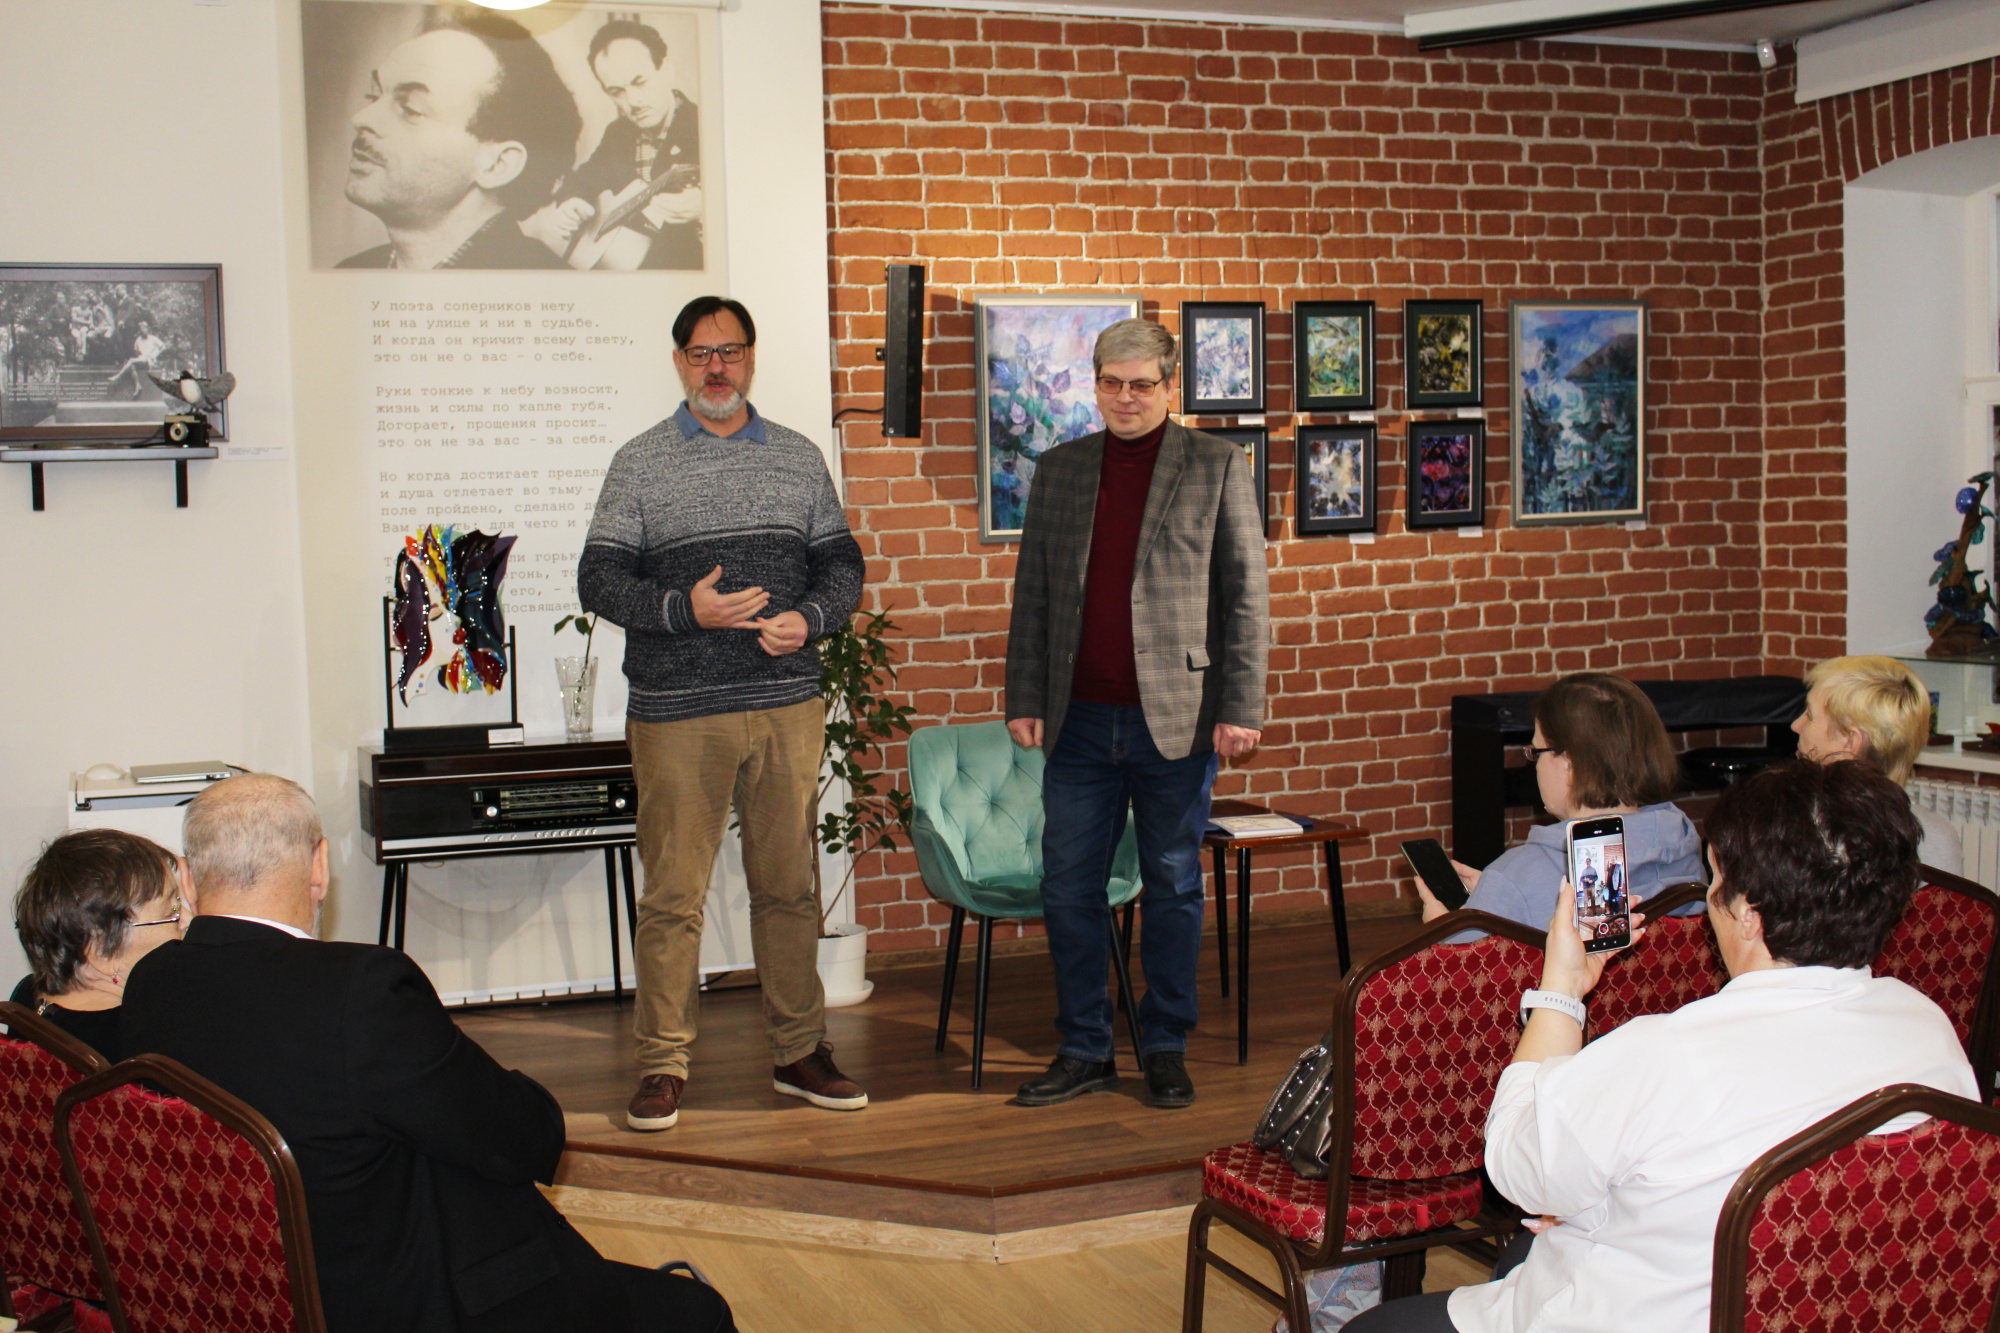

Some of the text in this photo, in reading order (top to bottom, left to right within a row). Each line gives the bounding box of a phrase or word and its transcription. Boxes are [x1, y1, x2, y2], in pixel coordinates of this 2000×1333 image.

[370, 300, 576, 314] У поэта соперников нету
[372, 317, 600, 331] ни на улице и ни в судьбе.
[372, 334, 634, 348] И когда он кричит всему свету,
[373, 353, 401, 363] это
[409, 353, 428, 363] он
[436, 353, 455, 363] не
[463, 353, 473, 363] о
[481, 353, 508, 362] вас
[533, 352, 543, 362] о
[551, 350, 593, 362] себе.
[375, 384, 619, 399] Руки тонкие к небу возносит,
[375, 400, 612, 414] жизнь и силы по капле губя.
[376, 419, 455, 433] Догорает,
[466, 419, 537, 433] прощения
[377, 438, 405, 448] это
[413, 438, 432, 448] он
[440, 437, 459, 447] не
[467, 437, 485, 447] за
[493, 436, 520, 447] вас
[546, 436, 564, 445] за
[572, 433, 613, 445] себя.
[379, 471, 398, 483] Но
[406, 471, 451, 482] когда
[459, 469, 539, 481] достигает
[379, 490, 390, 500] и
[398, 489, 434, 501] душа
[442, 487, 514, 498] отлетает
[522, 486, 540, 496] во
[548, 485, 584, 497] тьму
[380, 506, 417, 517] поле
[426, 503, 503, 518] пройдено,
[514, 502, 576, 513] сделано
[381, 522, 410, 534] Вам
[490, 521, 515, 530] для
[523, 519, 559, 529] чего
[567, 519, 577, 528] и
[509, 586, 542, 597] его,
